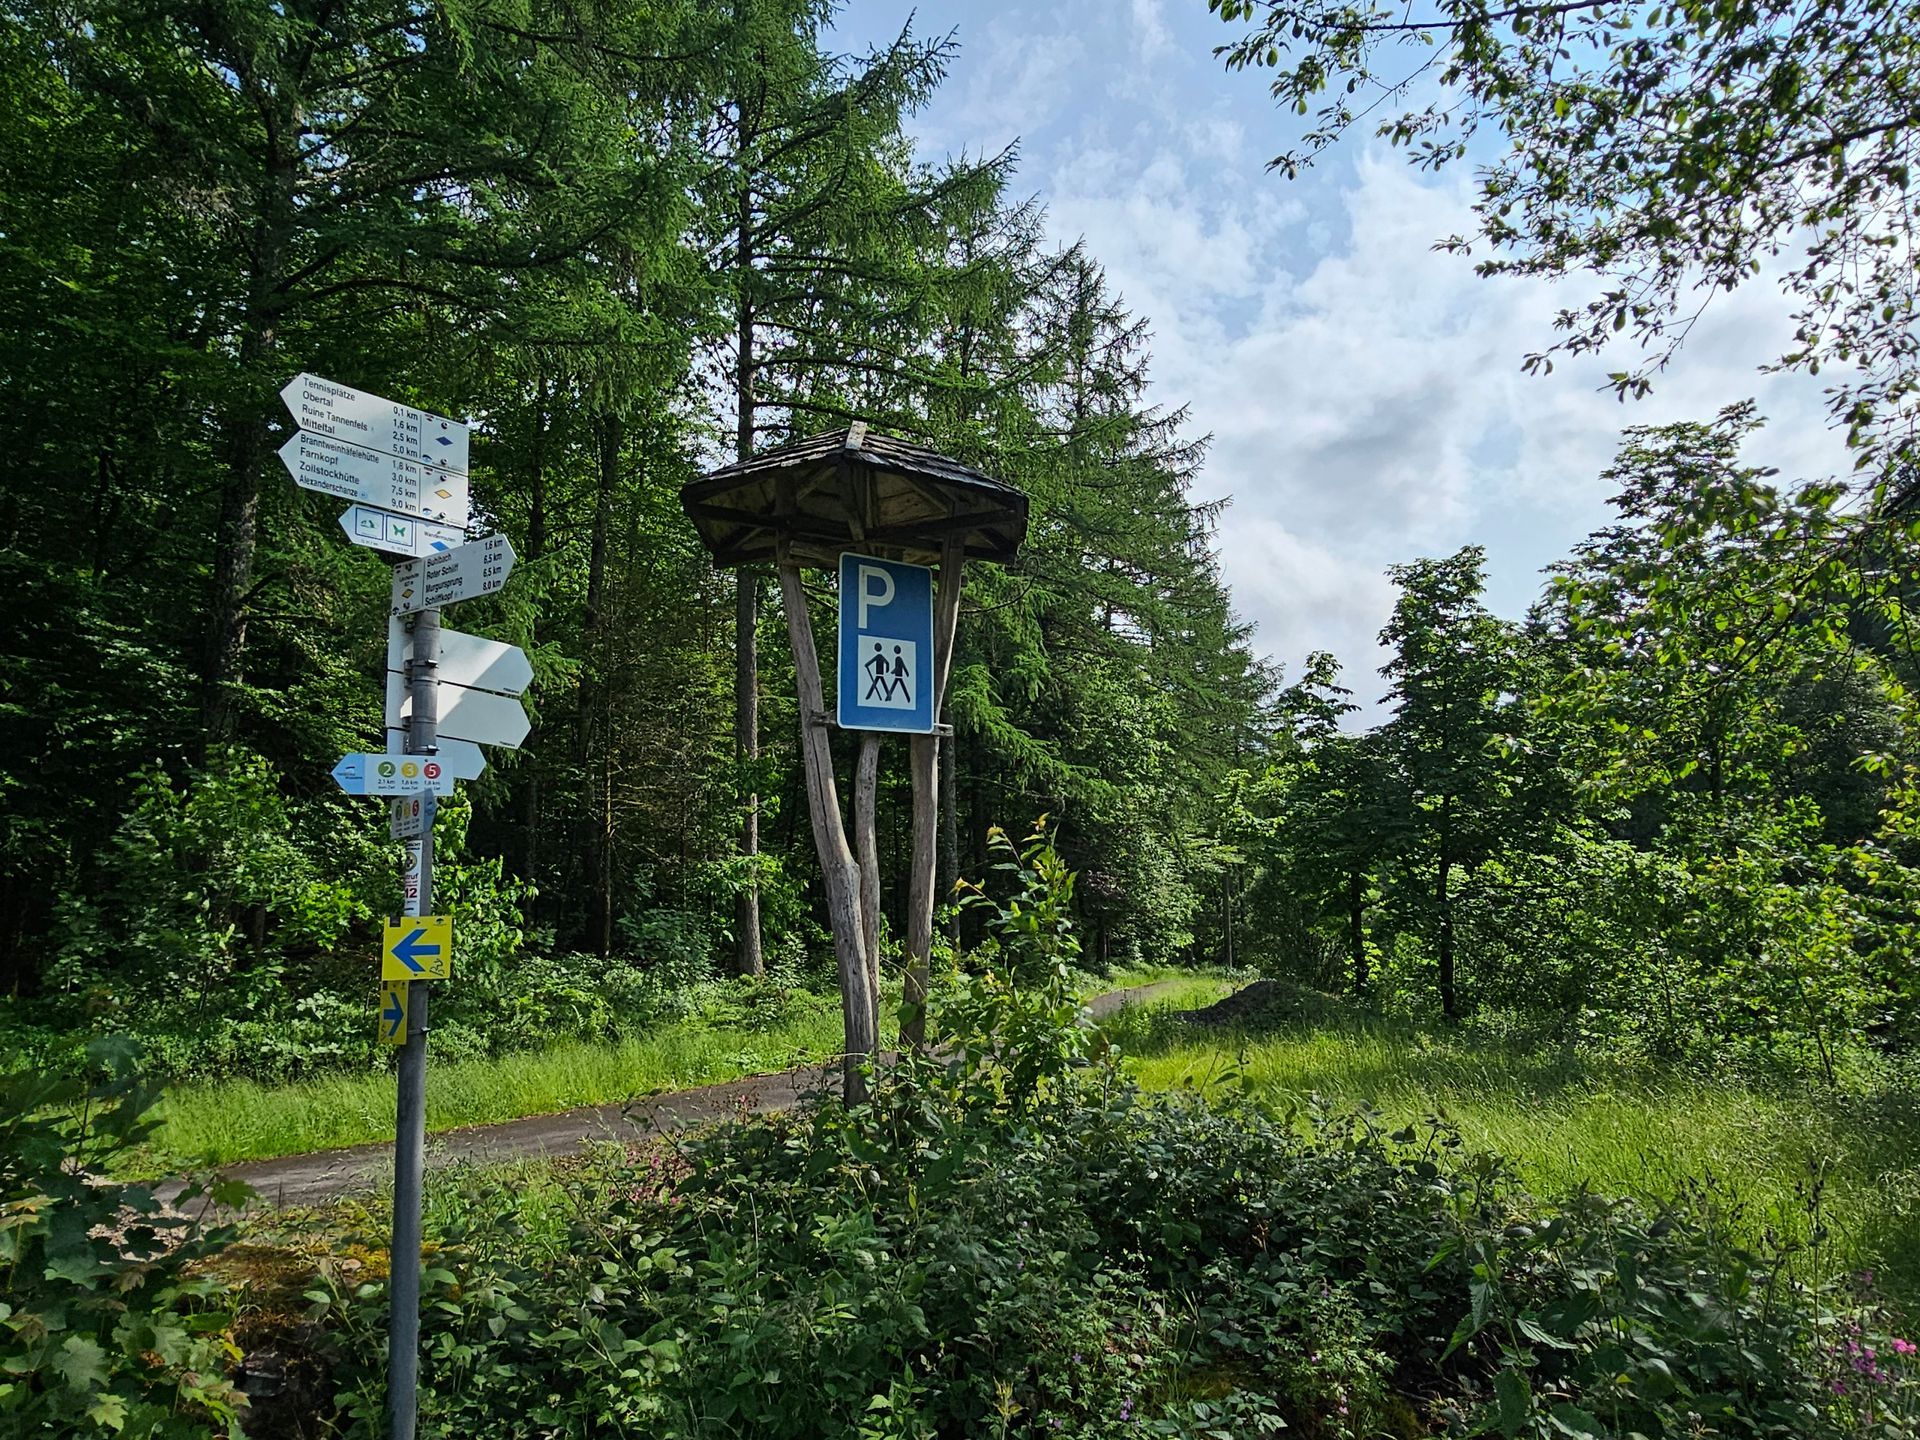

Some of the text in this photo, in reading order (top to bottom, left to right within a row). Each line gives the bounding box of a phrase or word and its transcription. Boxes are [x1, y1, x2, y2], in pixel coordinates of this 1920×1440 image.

[303, 377, 418, 420] Tennisplätze 0,1 km
[303, 390, 417, 432] Obertal 1,6 km
[302, 404, 417, 445] Ruine Tannenfels 2,5 km
[302, 417, 417, 458] Mitteltal 5,0 km
[300, 434, 416, 474] Branntweinhäfelehütte 1,8 km
[300, 447, 416, 486] Farnkopf 3,0 km
[299, 474, 416, 512] Alexanderschanze 9,0 km
[300, 461, 416, 499] Zollstockhütte 7,5 km
[426, 577, 462, 593] Murgursprung
[427, 569, 441, 580] Roter
[484, 554, 492, 564] 6,5
[494, 553, 502, 561] km
[425, 579, 501, 606] Schliffkopf 8,0 km
[858, 564, 895, 629] P
[383, 764, 392, 776] 2
[407, 765, 414, 776] 3
[428, 765, 436, 777] 5
